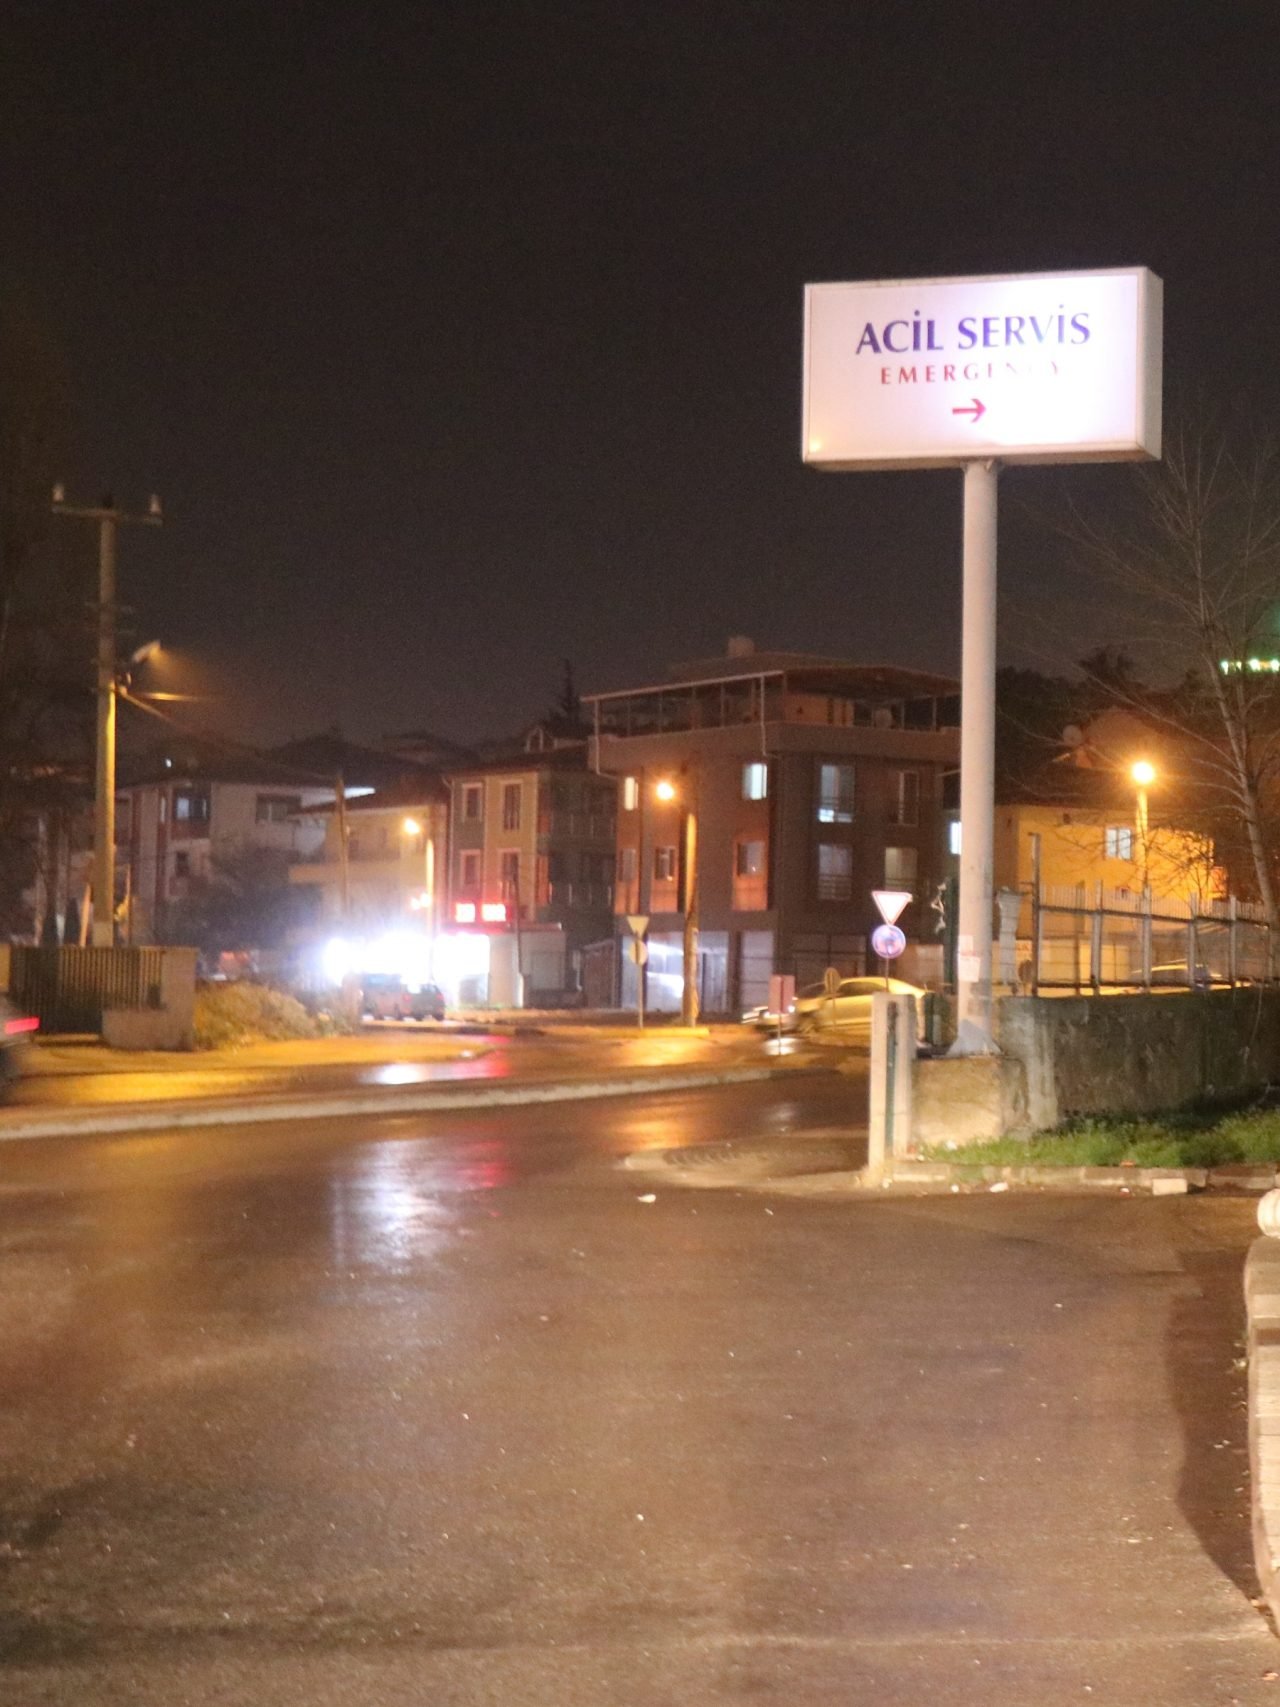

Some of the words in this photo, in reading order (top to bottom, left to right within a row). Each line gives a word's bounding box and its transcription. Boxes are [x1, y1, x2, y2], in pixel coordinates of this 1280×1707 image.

[855, 309, 944, 355] ACİL
[957, 303, 1091, 349] SERVİS
[880, 361, 1061, 385] EMERGENY
